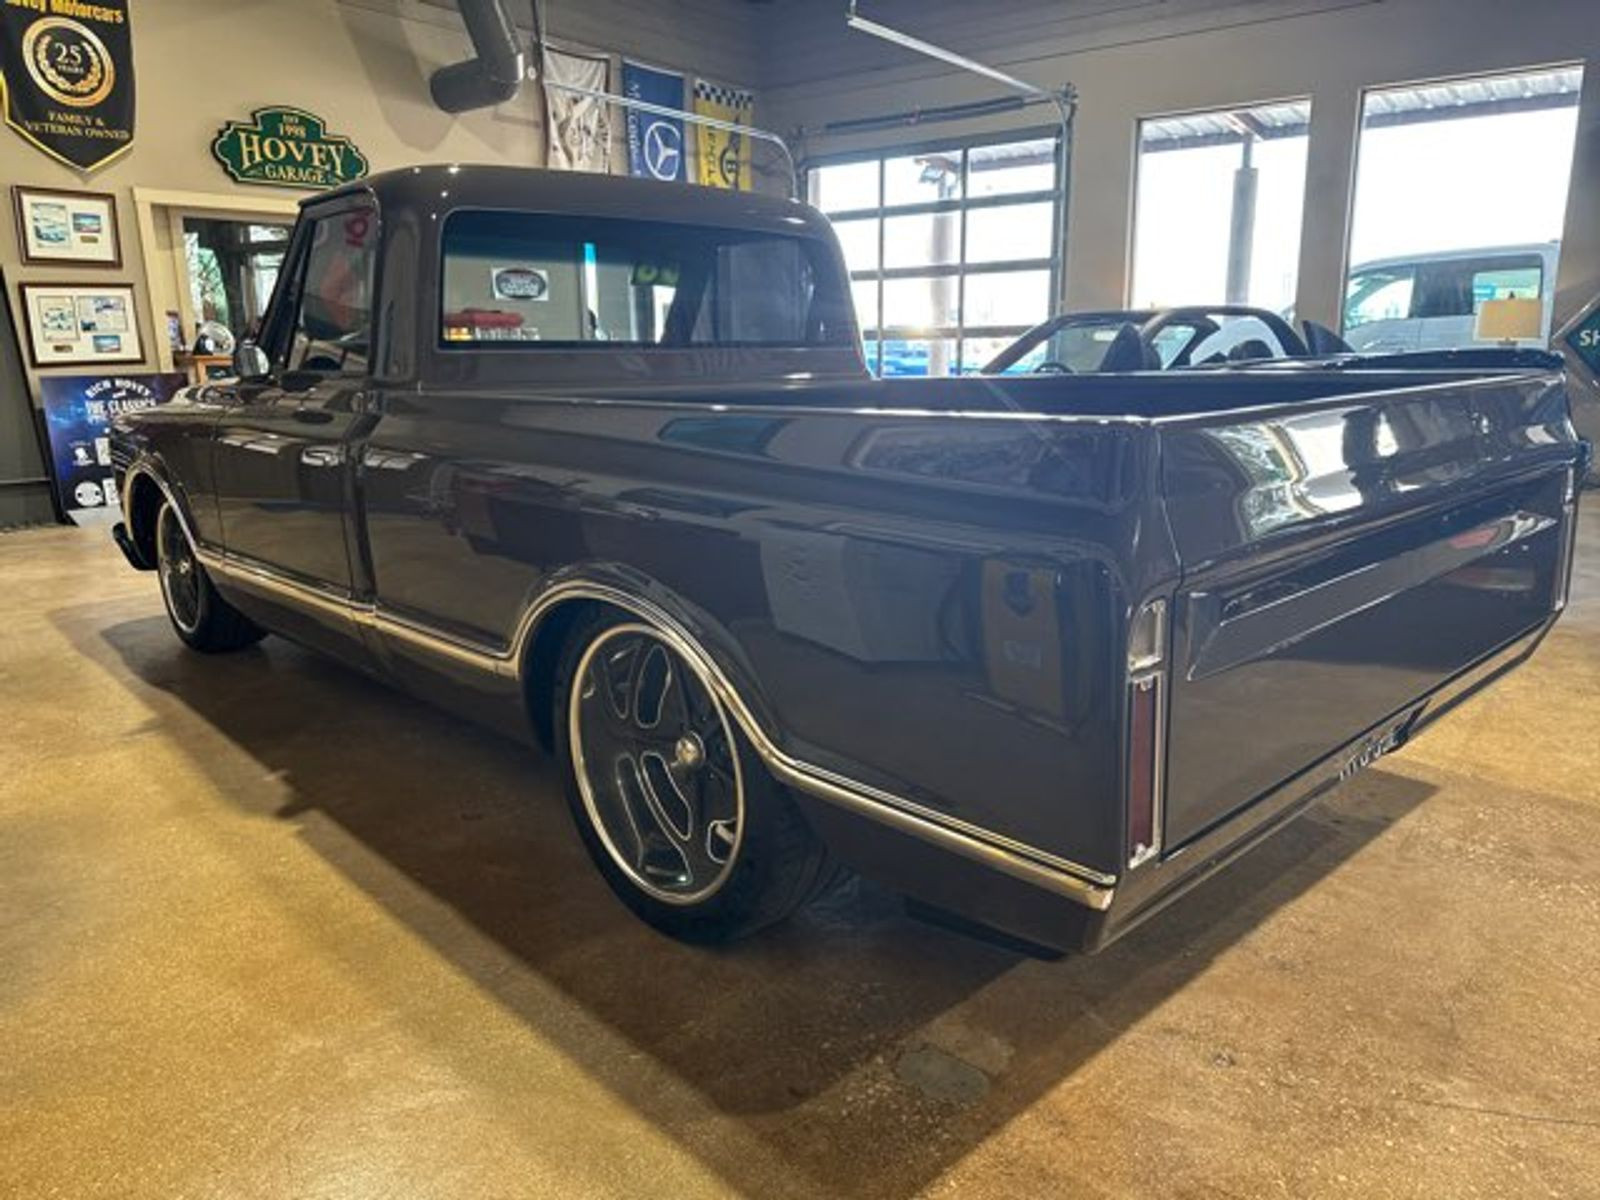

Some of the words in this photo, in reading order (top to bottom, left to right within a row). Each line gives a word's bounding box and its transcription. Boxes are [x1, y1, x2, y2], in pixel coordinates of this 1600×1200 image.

[55, 43, 82, 64] 25
[238, 131, 346, 177] HOVEY
[265, 163, 326, 183] GARAGE
[85, 379, 112, 398] RICH
[115, 378, 151, 396] HOVEY
